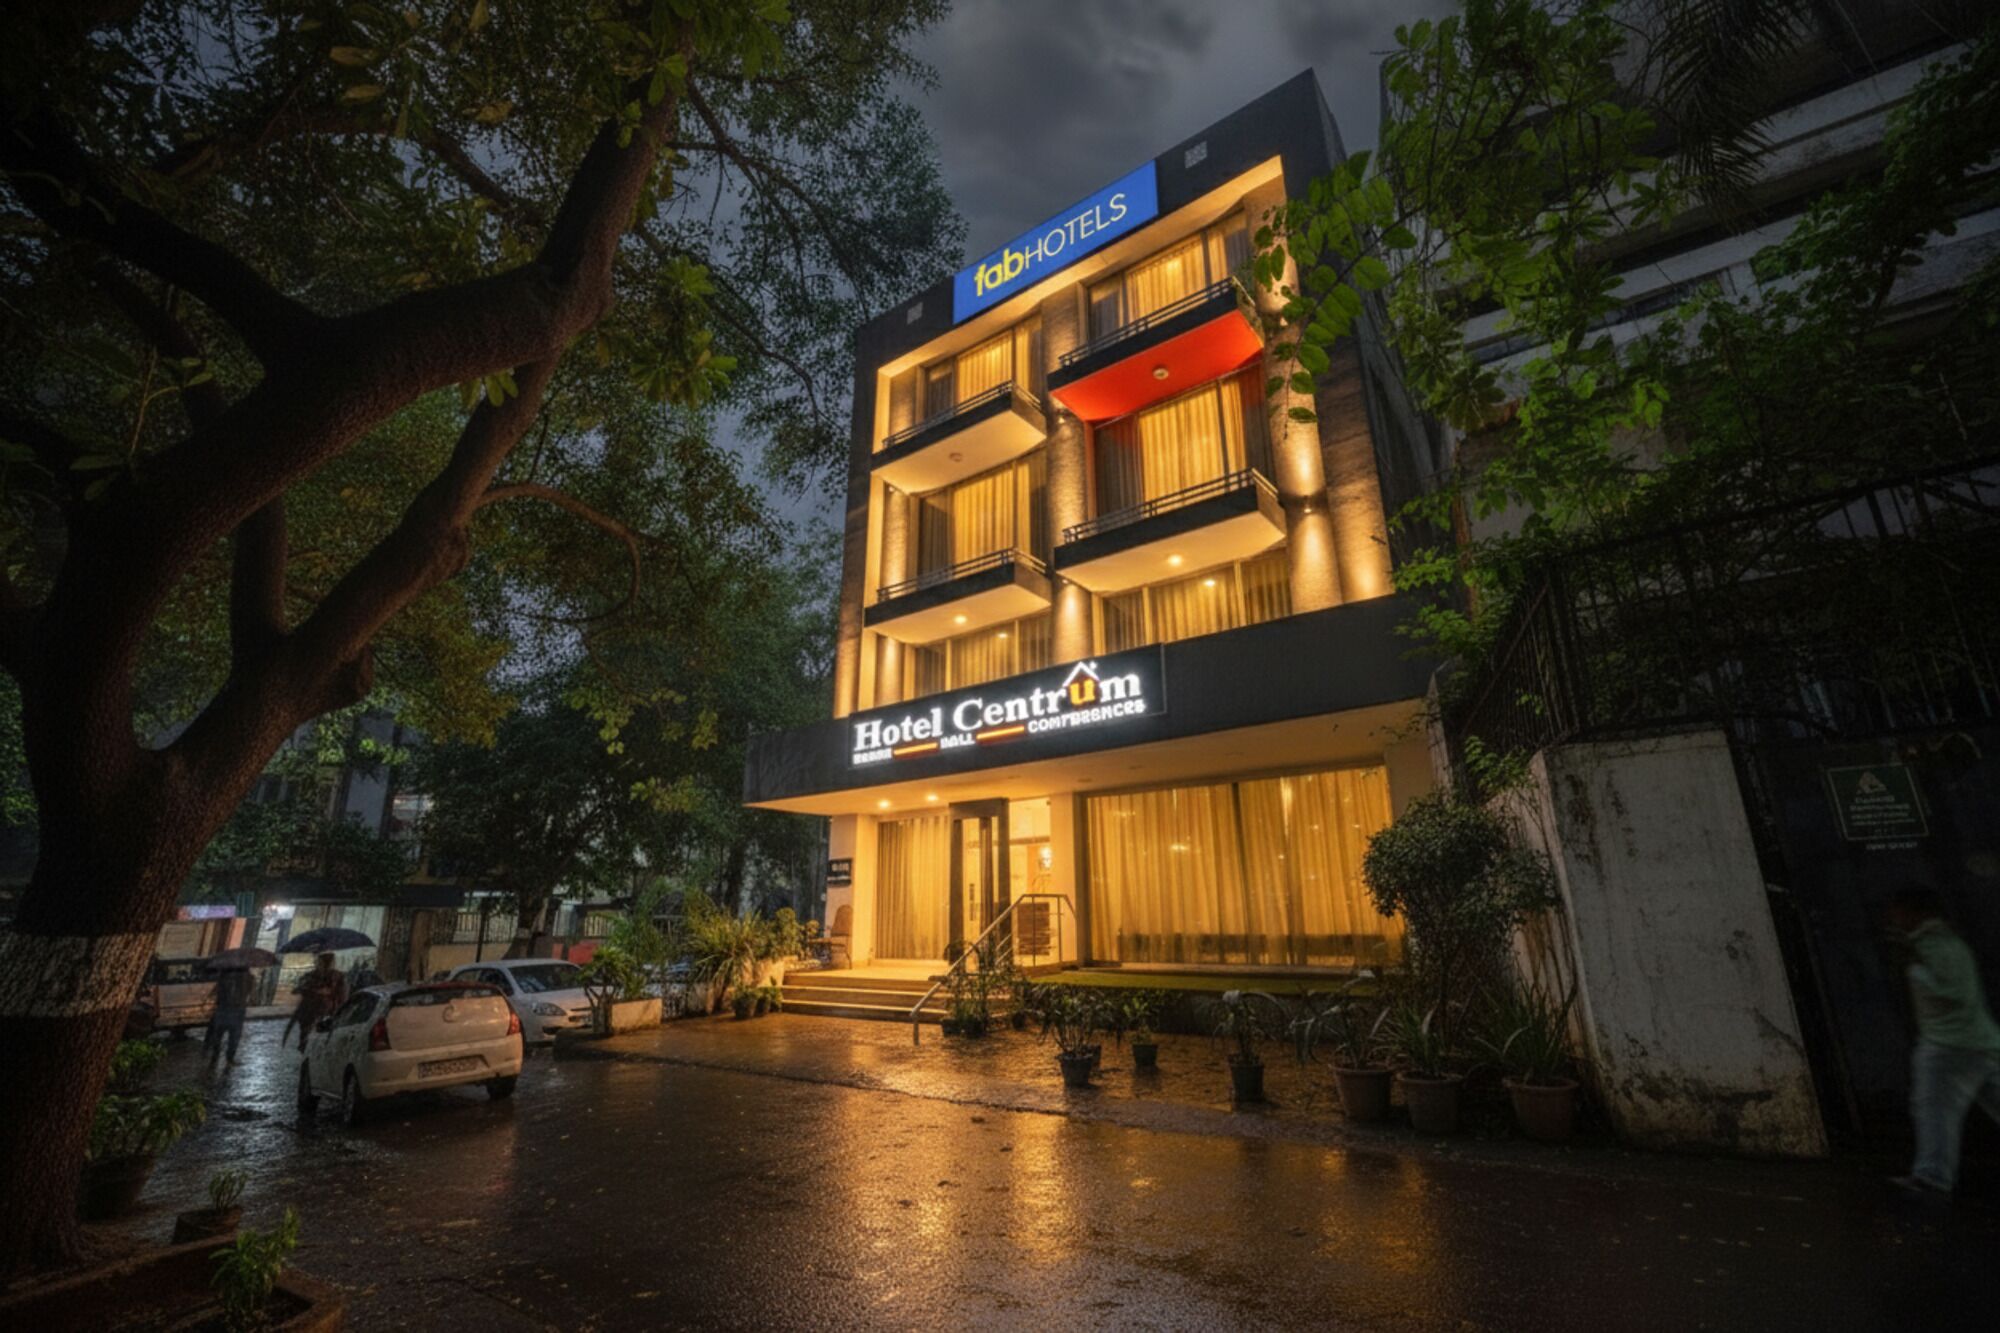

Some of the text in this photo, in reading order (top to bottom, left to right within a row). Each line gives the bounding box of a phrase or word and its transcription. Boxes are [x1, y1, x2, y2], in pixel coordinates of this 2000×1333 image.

[973, 193, 1128, 297] fabHOTELS
[854, 671, 1142, 750] Hotel Centrum
